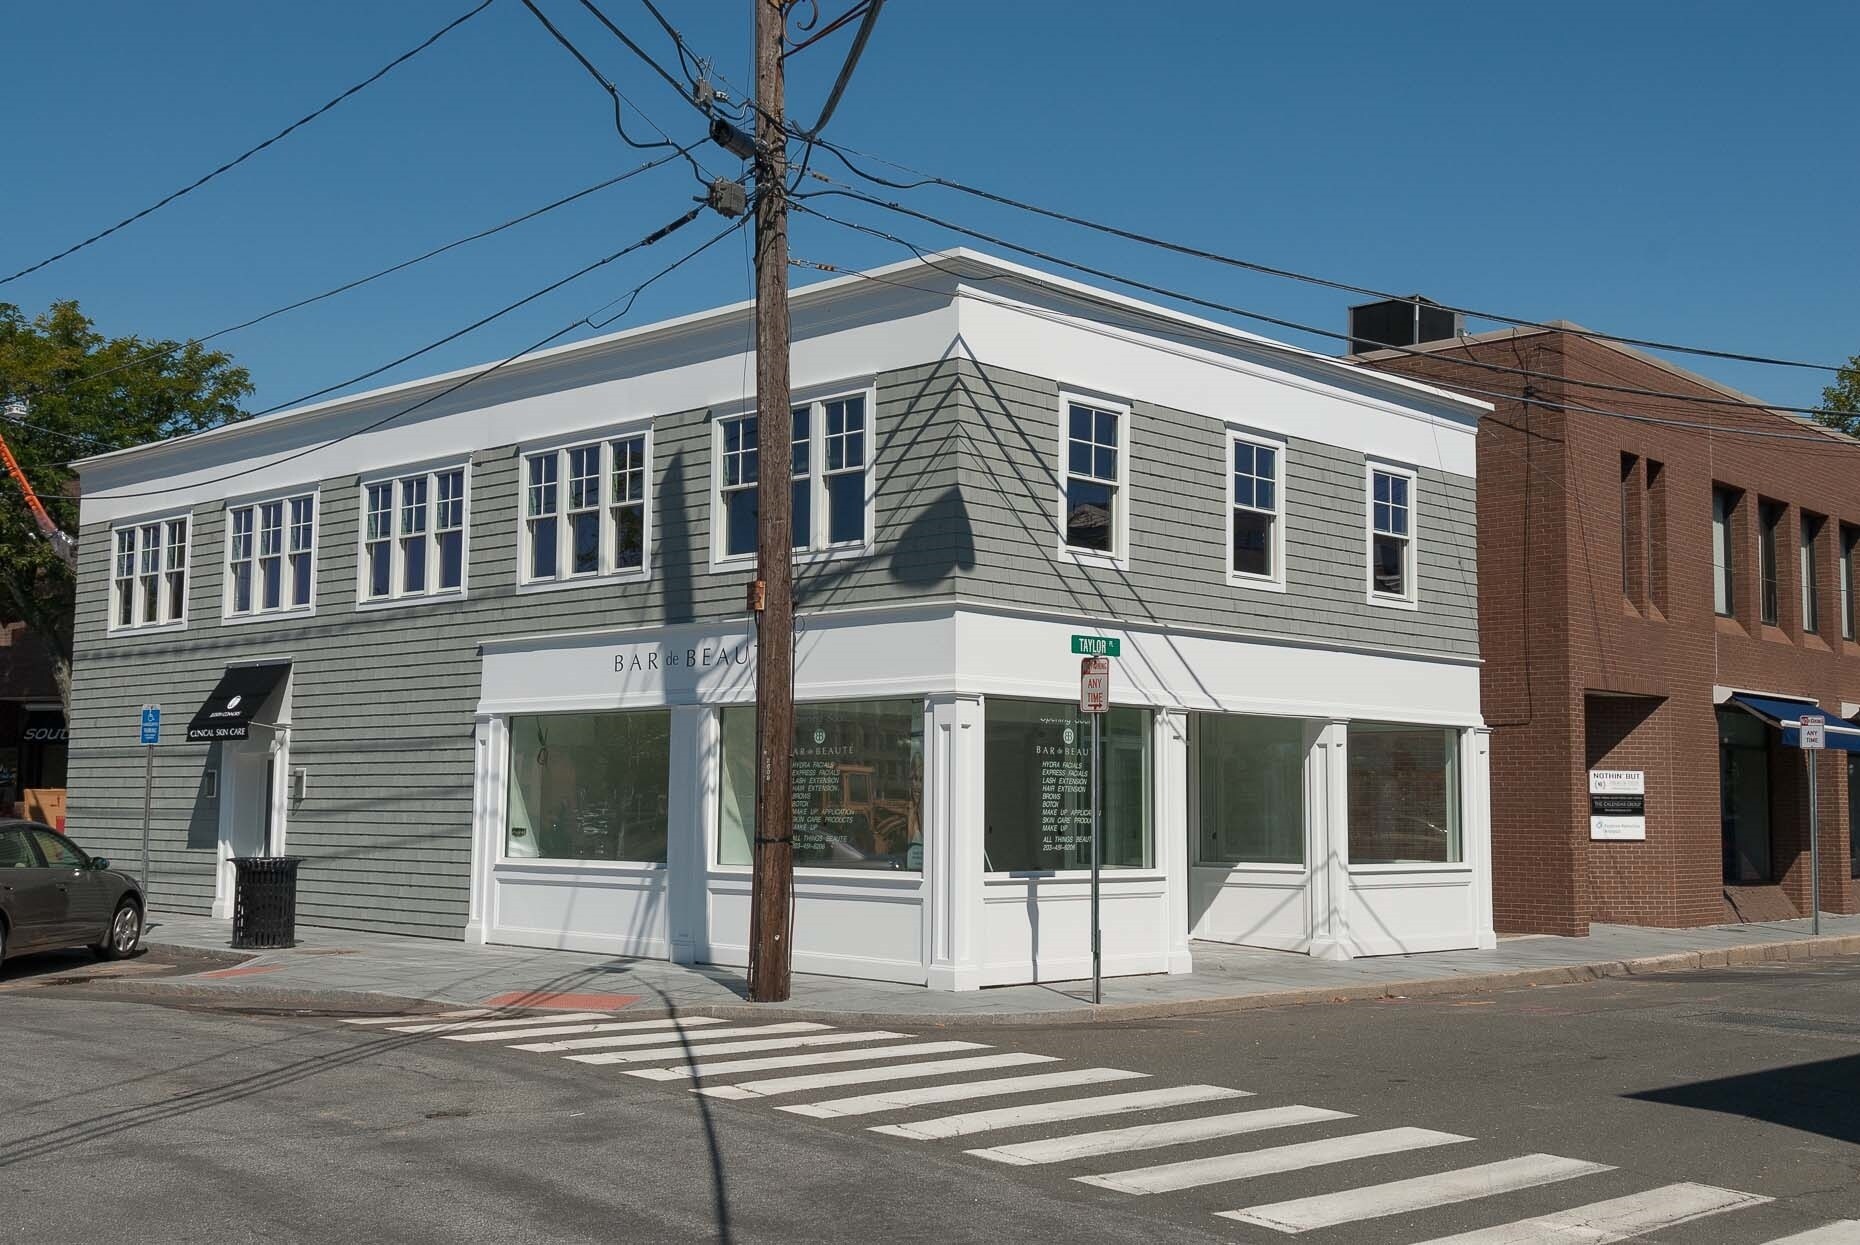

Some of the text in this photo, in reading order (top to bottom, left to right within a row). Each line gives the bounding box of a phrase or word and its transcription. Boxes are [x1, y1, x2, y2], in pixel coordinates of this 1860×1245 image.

[1079, 638, 1106, 653] TAYLOR
[614, 646, 748, 672] BAR de BEAU
[1088, 679, 1102, 688] ANY
[1087, 693, 1103, 703] TIME
[216, 728, 229, 736] SKIN
[230, 728, 246, 736] CARE
[1036, 746, 1055, 754] BAR
[1064, 747, 1089, 756] BEAU
[1062, 761, 1083, 769] FACIALS
[809, 776, 840, 784] EXTENSION
[1058, 777, 1088, 785] EXTENSION
[1057, 785, 1086, 793] EXTENSION
[1042, 808, 1057, 816] MAKE
[824, 816, 853, 824] PRODUCTS
